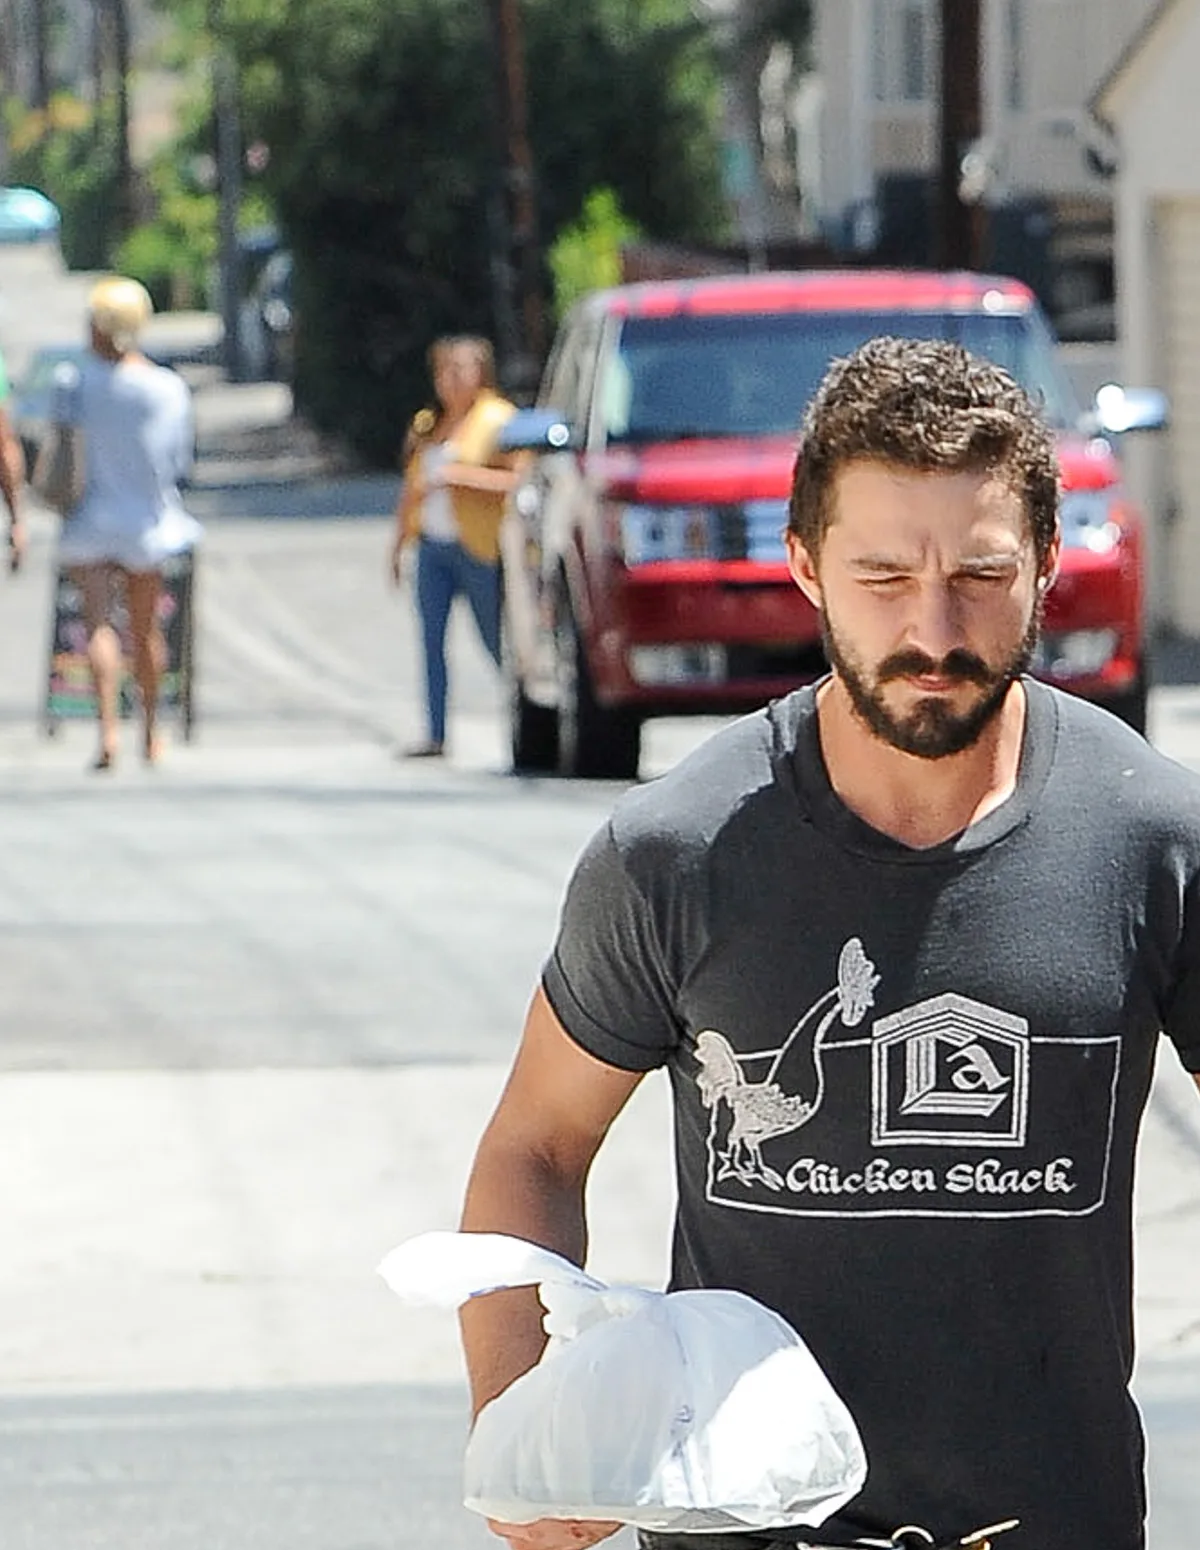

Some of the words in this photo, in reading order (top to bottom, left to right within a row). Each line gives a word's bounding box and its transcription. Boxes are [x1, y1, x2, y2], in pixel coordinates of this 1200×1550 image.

[899, 1029, 1011, 1116] La
[785, 1159, 937, 1194] Chicken
[945, 1158, 1076, 1193] Shack
